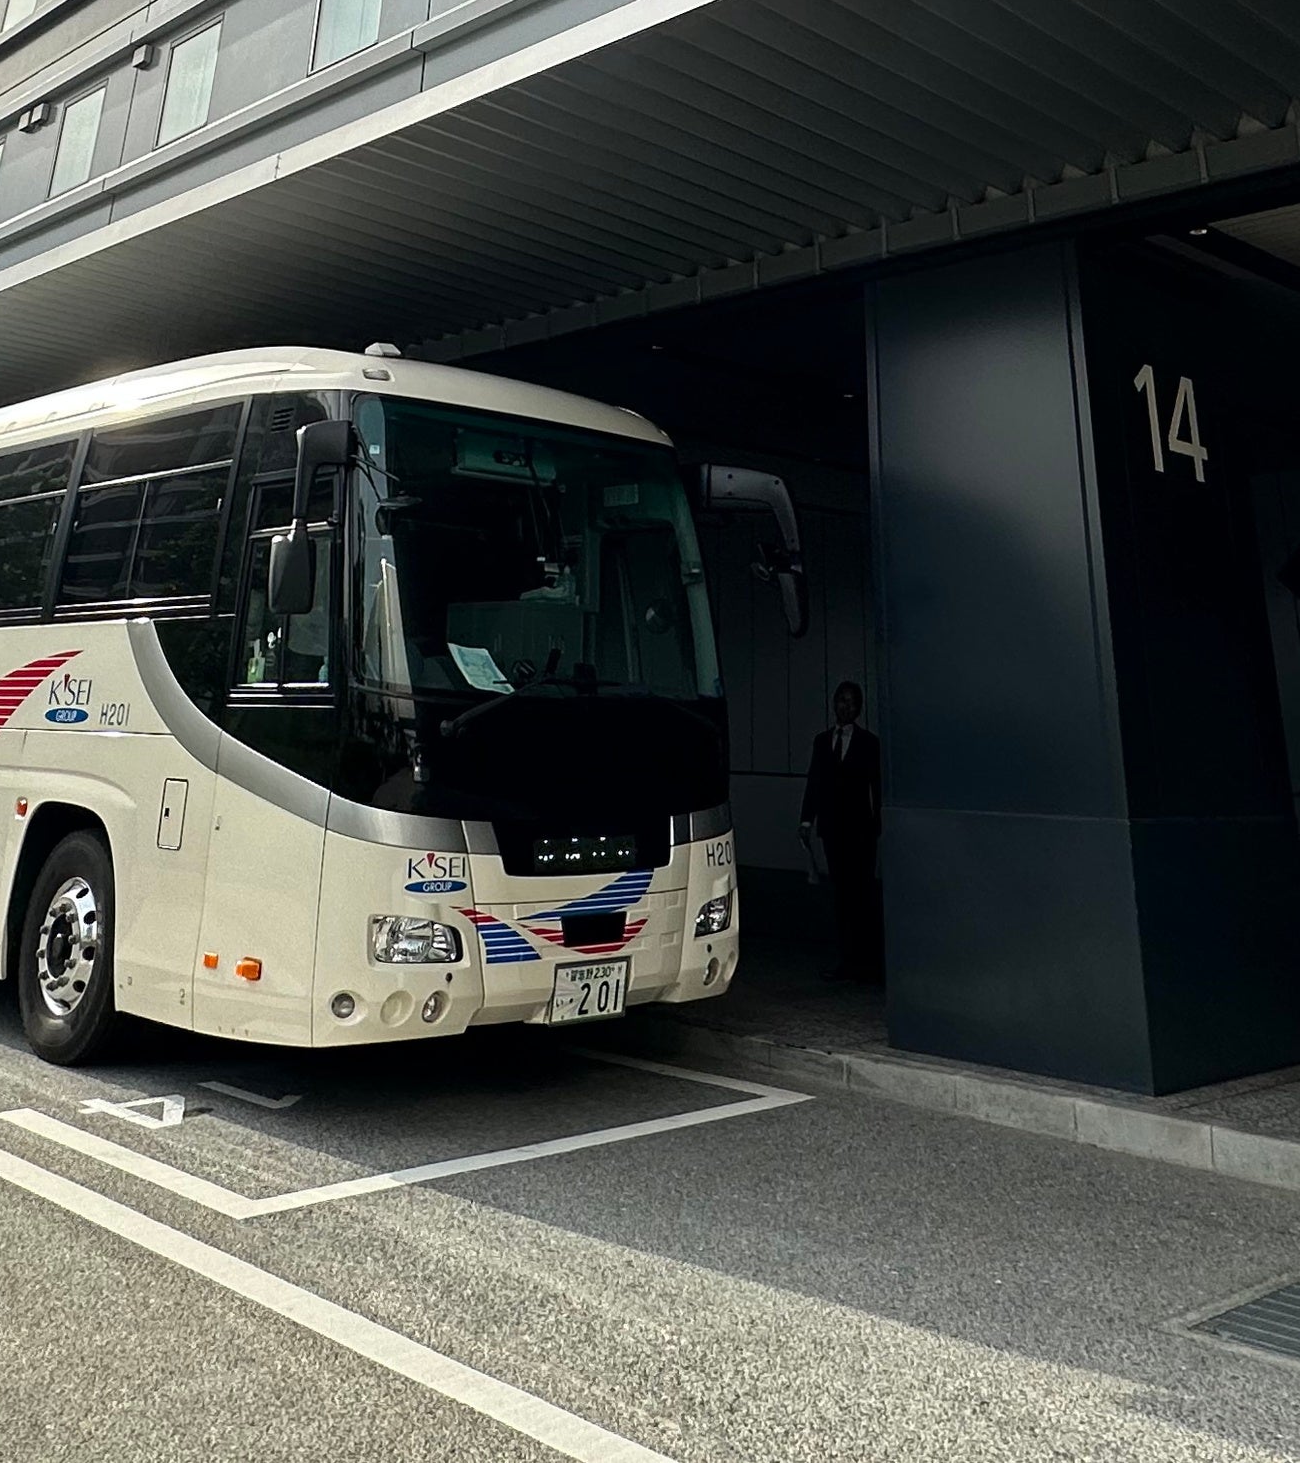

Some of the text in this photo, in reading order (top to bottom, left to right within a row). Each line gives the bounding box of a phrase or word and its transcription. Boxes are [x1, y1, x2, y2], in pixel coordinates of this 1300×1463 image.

[1133, 364, 1209, 483] 14
[100, 703, 131, 726] H201
[705, 840, 734, 867] H20
[422, 881, 453, 893] GROUP
